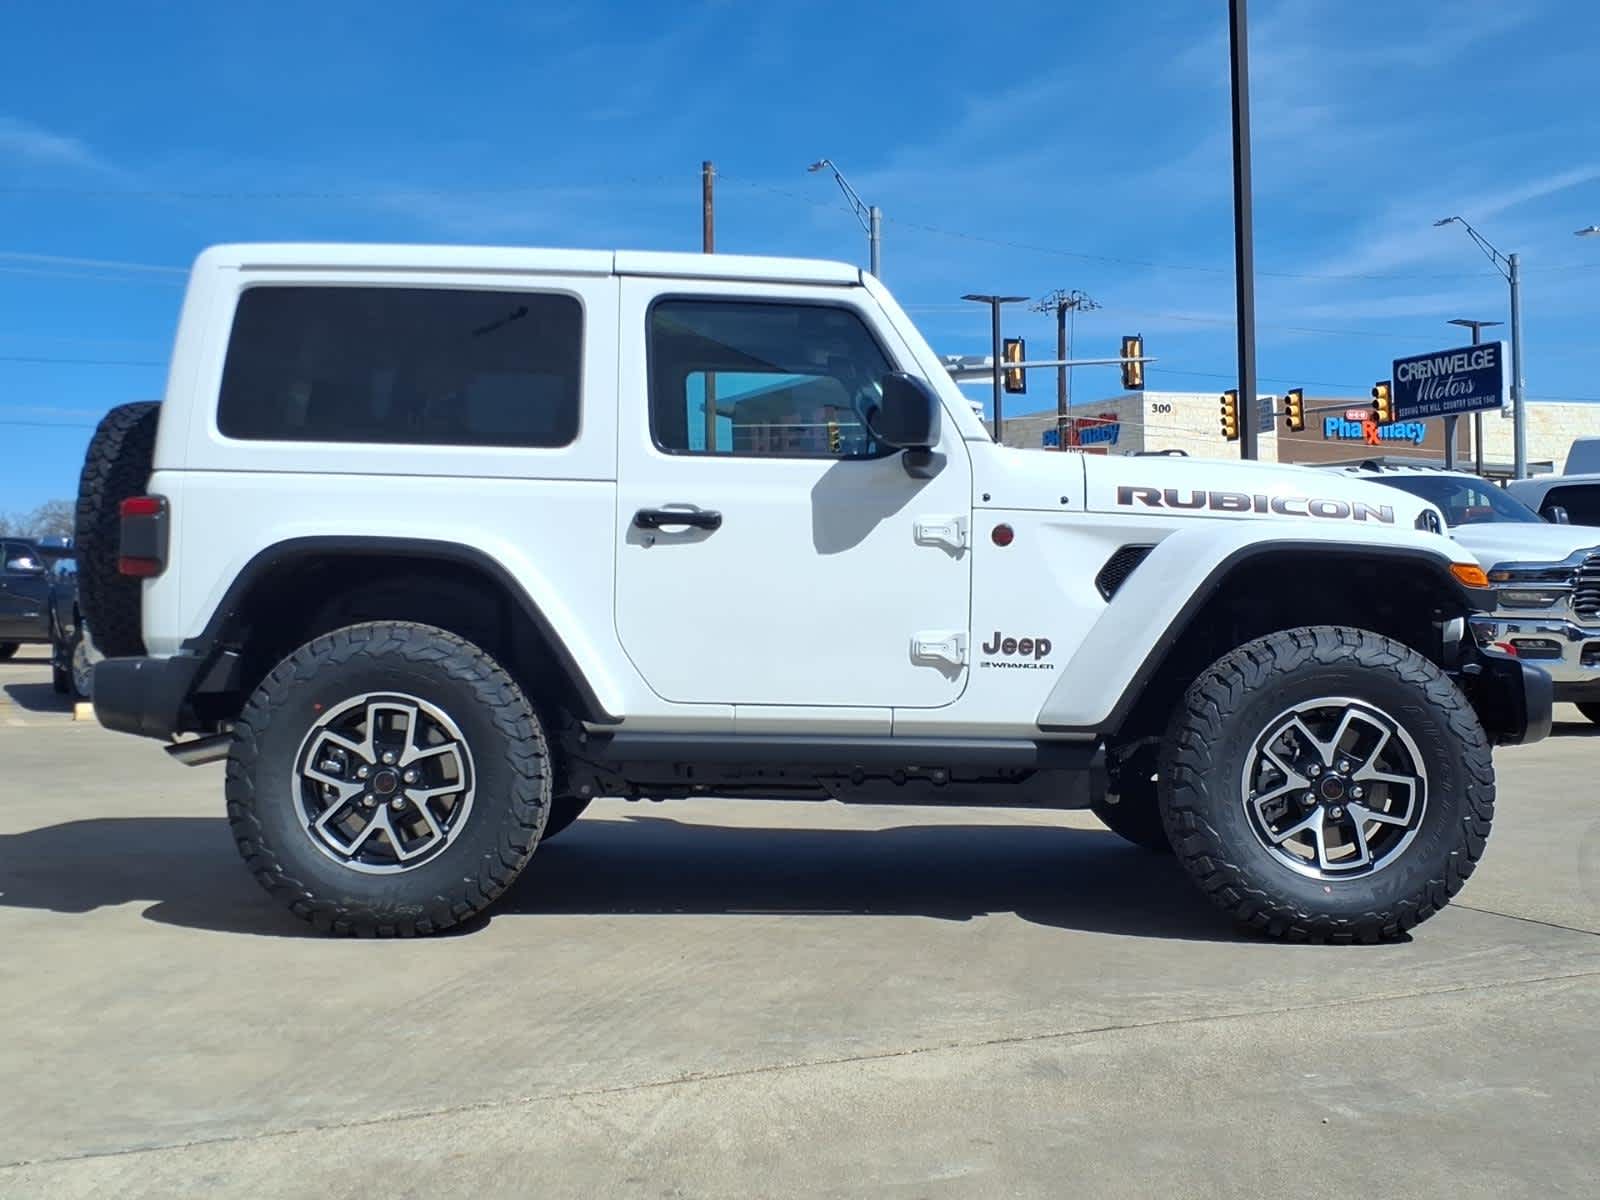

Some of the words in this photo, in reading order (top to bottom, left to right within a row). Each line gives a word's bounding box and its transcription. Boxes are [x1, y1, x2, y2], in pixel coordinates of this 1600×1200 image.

[1397, 348, 1496, 382] CRENWELGE
[1416, 375, 1475, 402] Motors
[1151, 403, 1172, 414] 300
[1117, 486, 1395, 525] RUBICON
[982, 631, 1052, 661] Jeep
[991, 661, 1055, 670] WRANGLER
